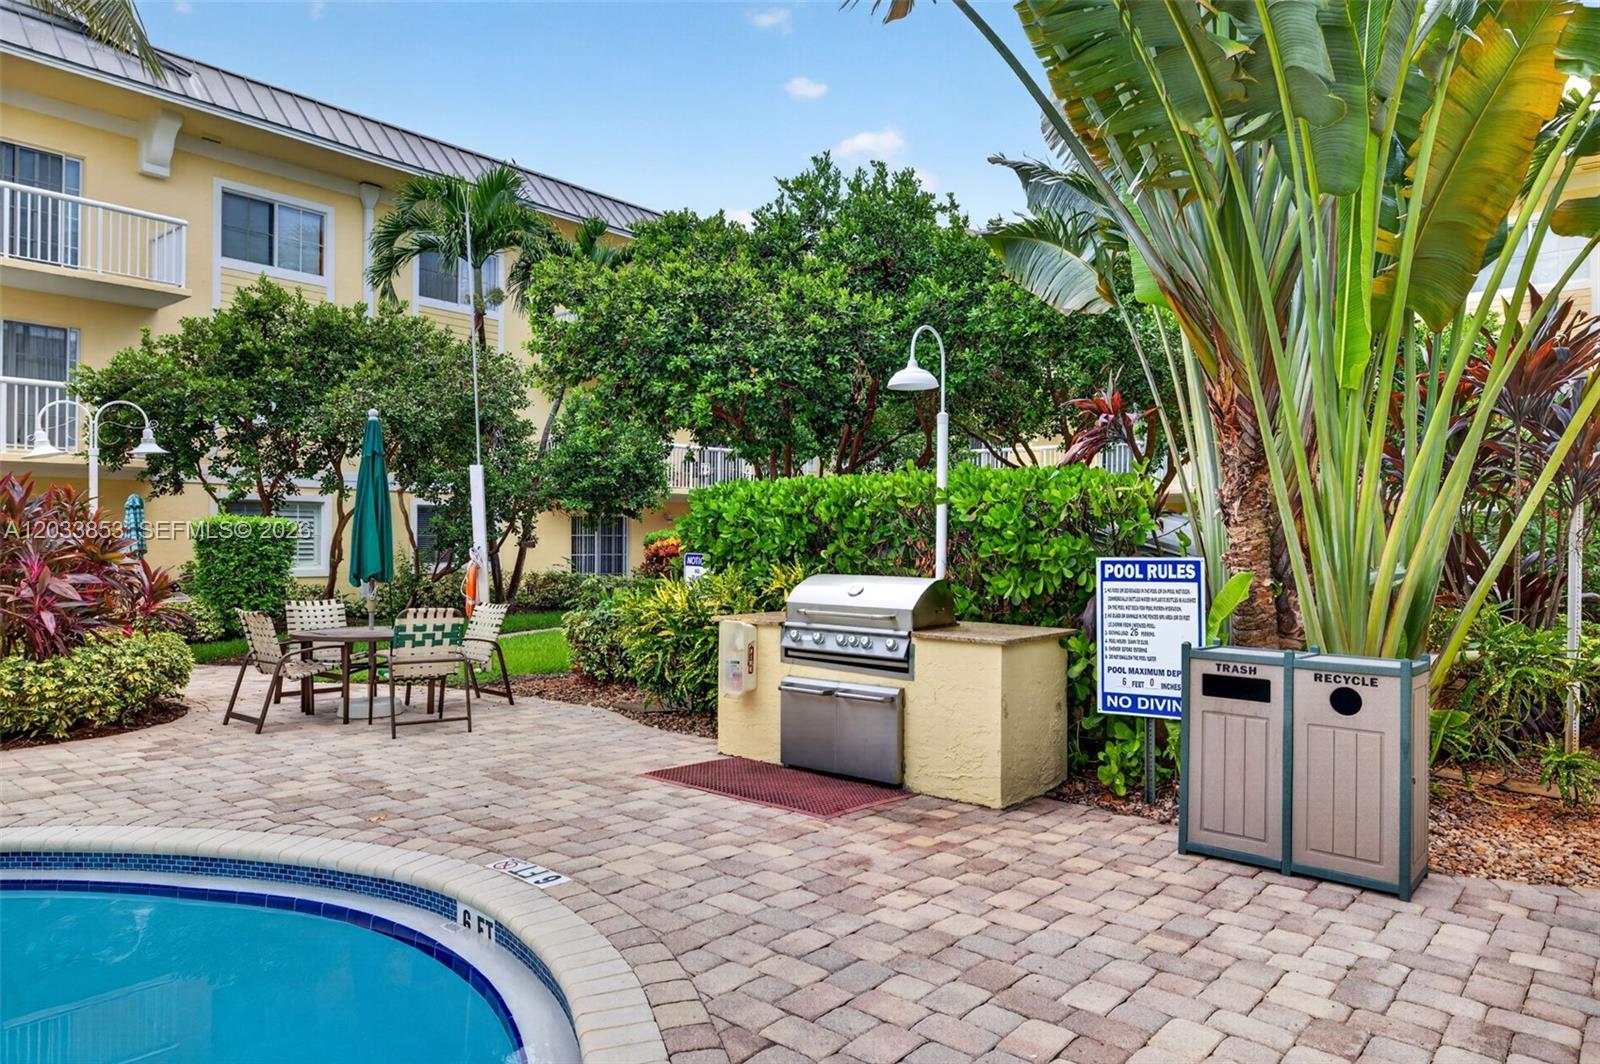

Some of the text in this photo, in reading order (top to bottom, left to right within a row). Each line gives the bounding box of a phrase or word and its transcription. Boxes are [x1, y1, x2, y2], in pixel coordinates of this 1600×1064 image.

[1104, 563, 1197, 579] POOL RULES
[1107, 666, 1182, 678] POOL MAXIMUM DEP
[1215, 663, 1257, 675] TRASH
[1122, 677, 1127, 686] 6
[1132, 680, 1145, 689] FEET
[1160, 682, 1182, 691] INCHES
[1313, 672, 1379, 688] RECYCLE
[1106, 694, 1182, 713] NO DIVIN
[463, 909, 493, 940] 6 FT
